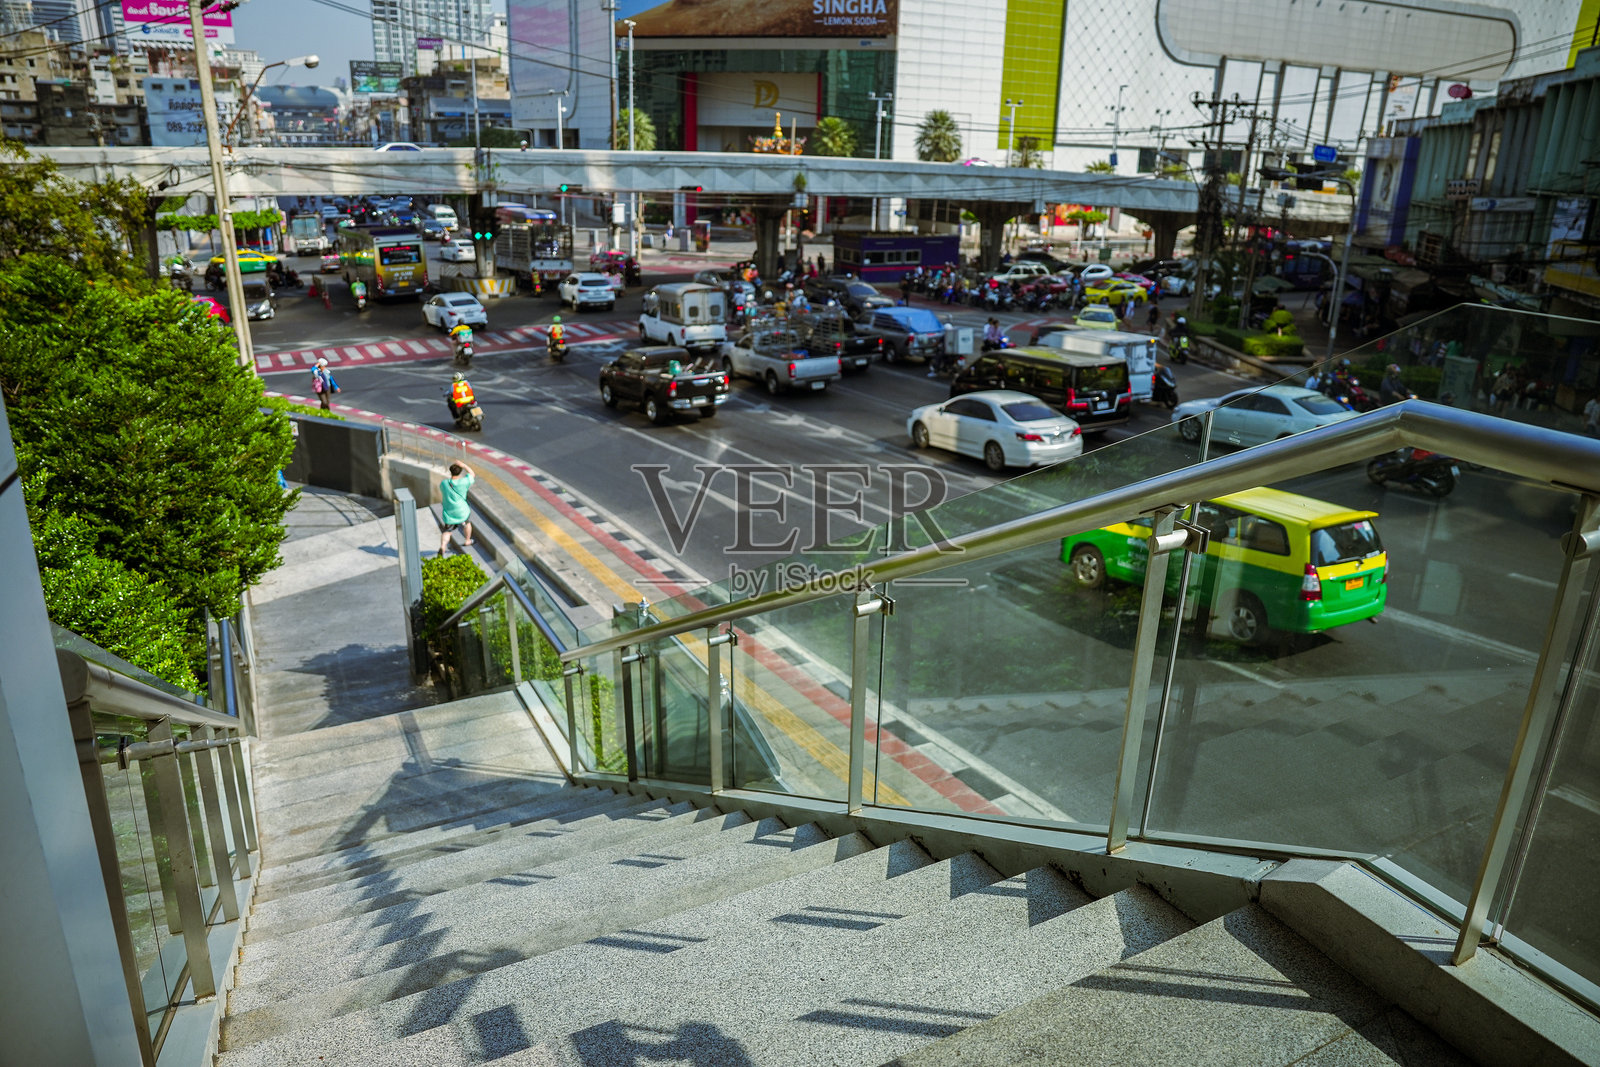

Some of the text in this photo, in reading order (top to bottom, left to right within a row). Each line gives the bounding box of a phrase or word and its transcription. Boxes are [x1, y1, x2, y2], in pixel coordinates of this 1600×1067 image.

[812, 0, 888, 14] SINGHA
[823, 16, 877, 26] LEMON SODA
